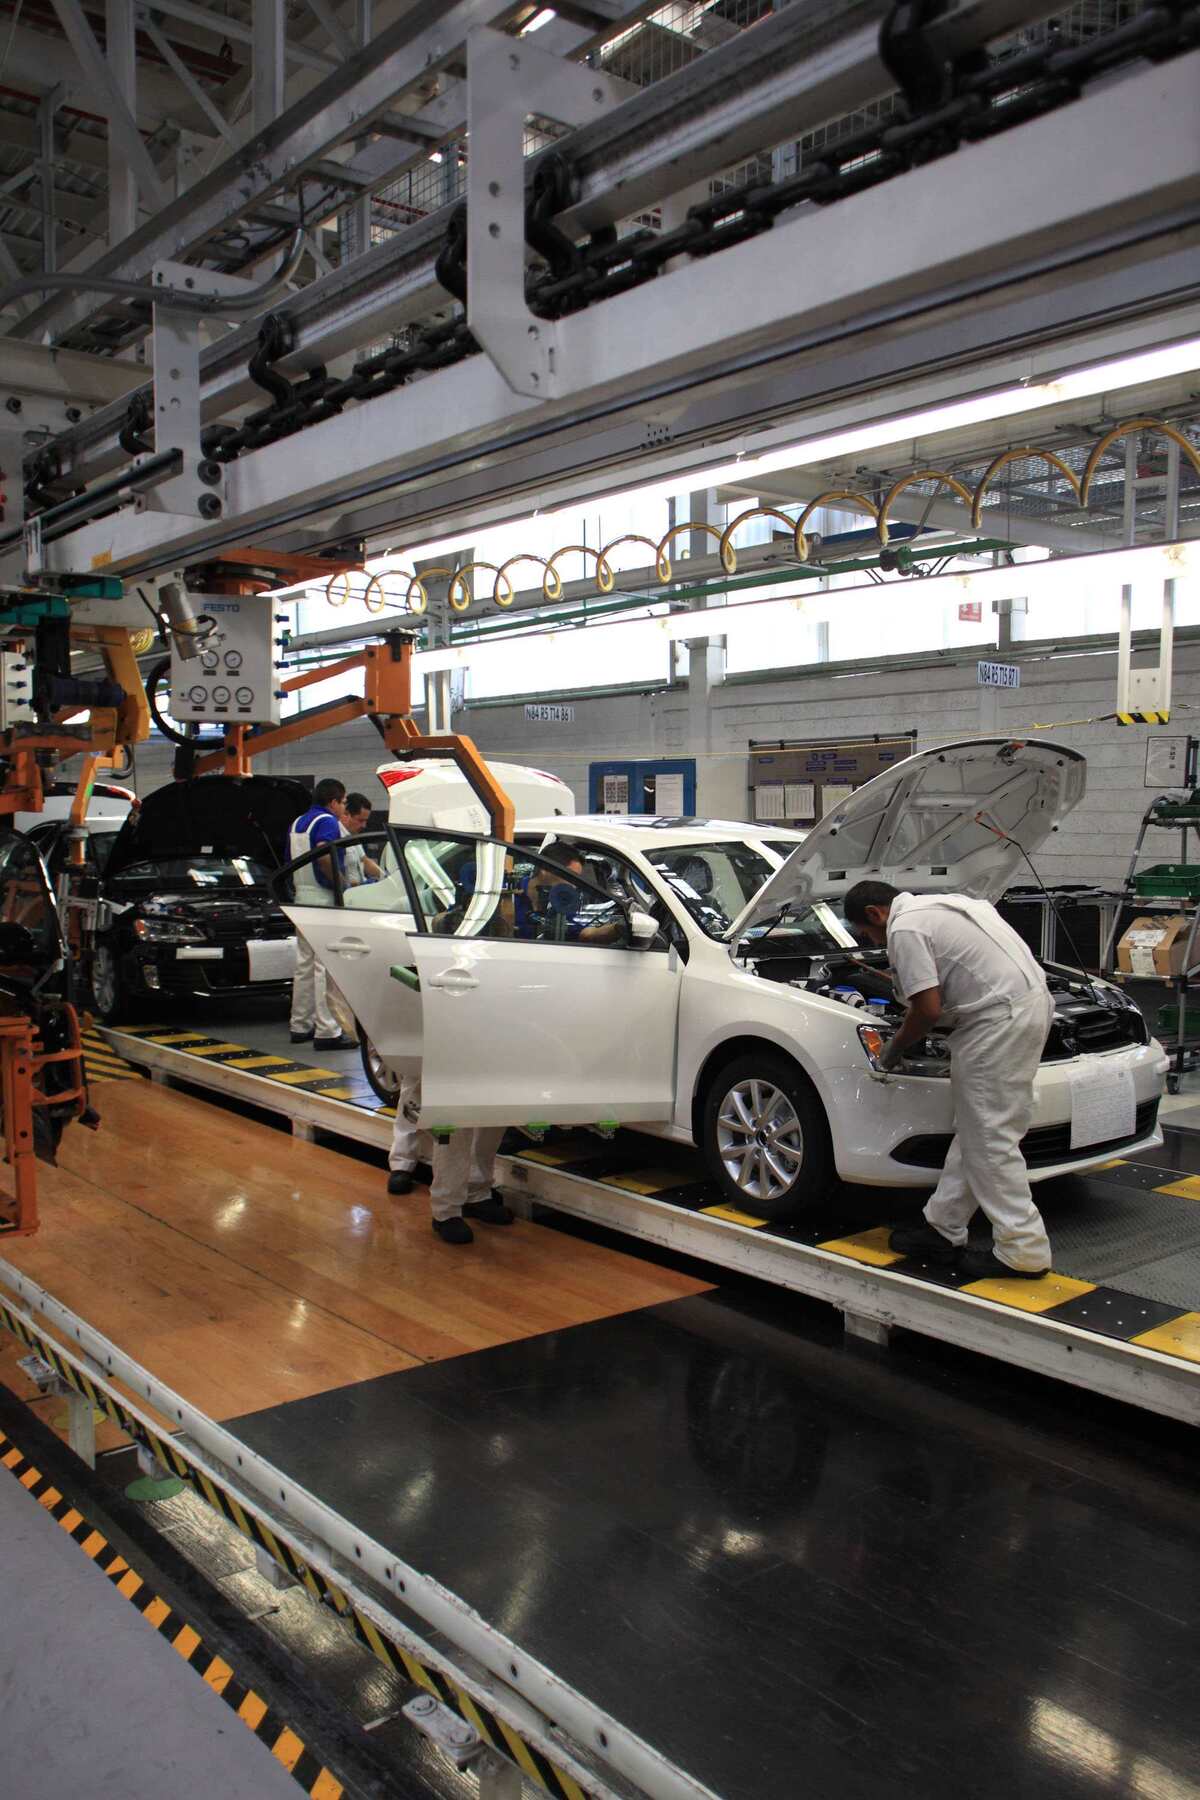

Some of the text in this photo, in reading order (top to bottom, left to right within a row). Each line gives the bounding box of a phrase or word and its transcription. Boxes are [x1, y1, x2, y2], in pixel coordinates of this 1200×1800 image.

[203, 603, 240, 612] FESTO
[979, 663, 990, 682] N84
[526, 706, 539, 720] N84
